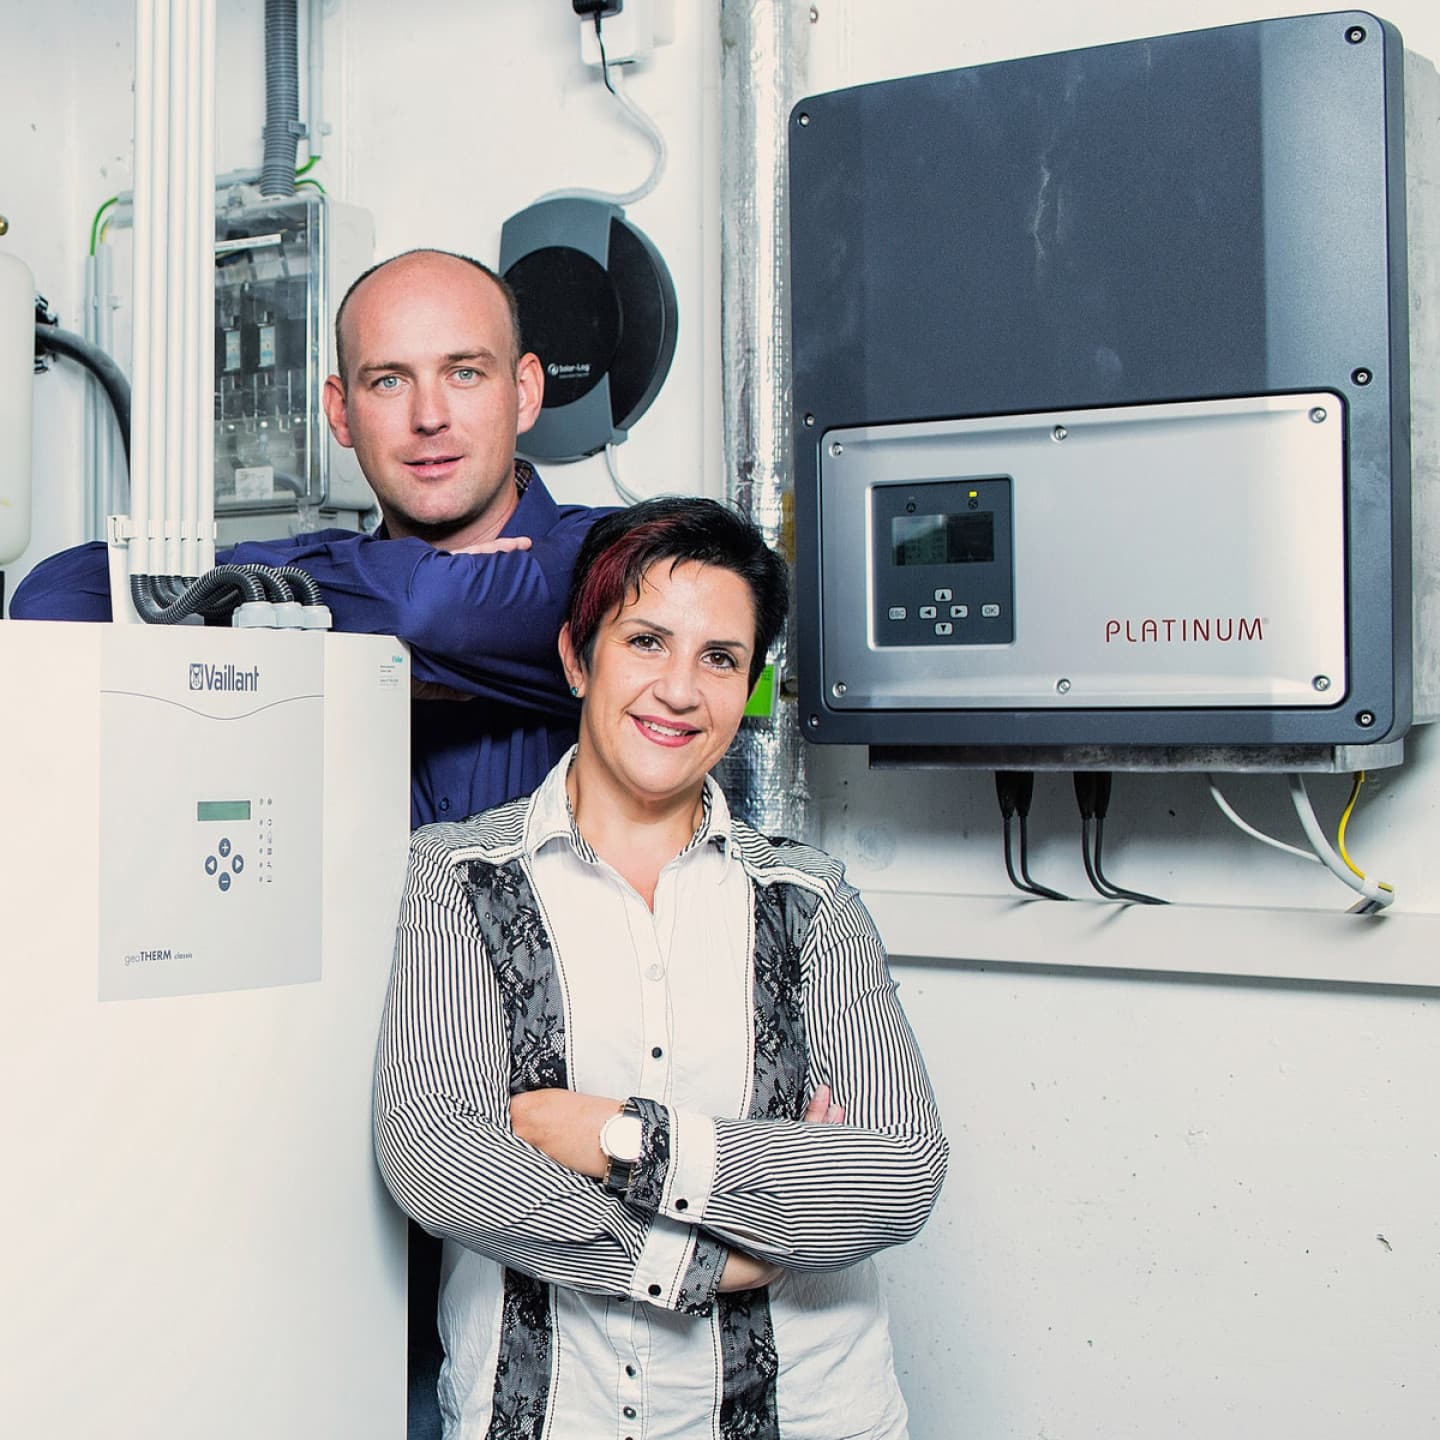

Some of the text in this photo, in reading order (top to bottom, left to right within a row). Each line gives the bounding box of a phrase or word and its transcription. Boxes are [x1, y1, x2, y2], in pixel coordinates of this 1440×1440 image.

[984, 607, 997, 616] OK
[1106, 618, 1263, 643] PLATINUM
[204, 663, 260, 692] Vaillant
[124, 950, 172, 966] geoTHERM
